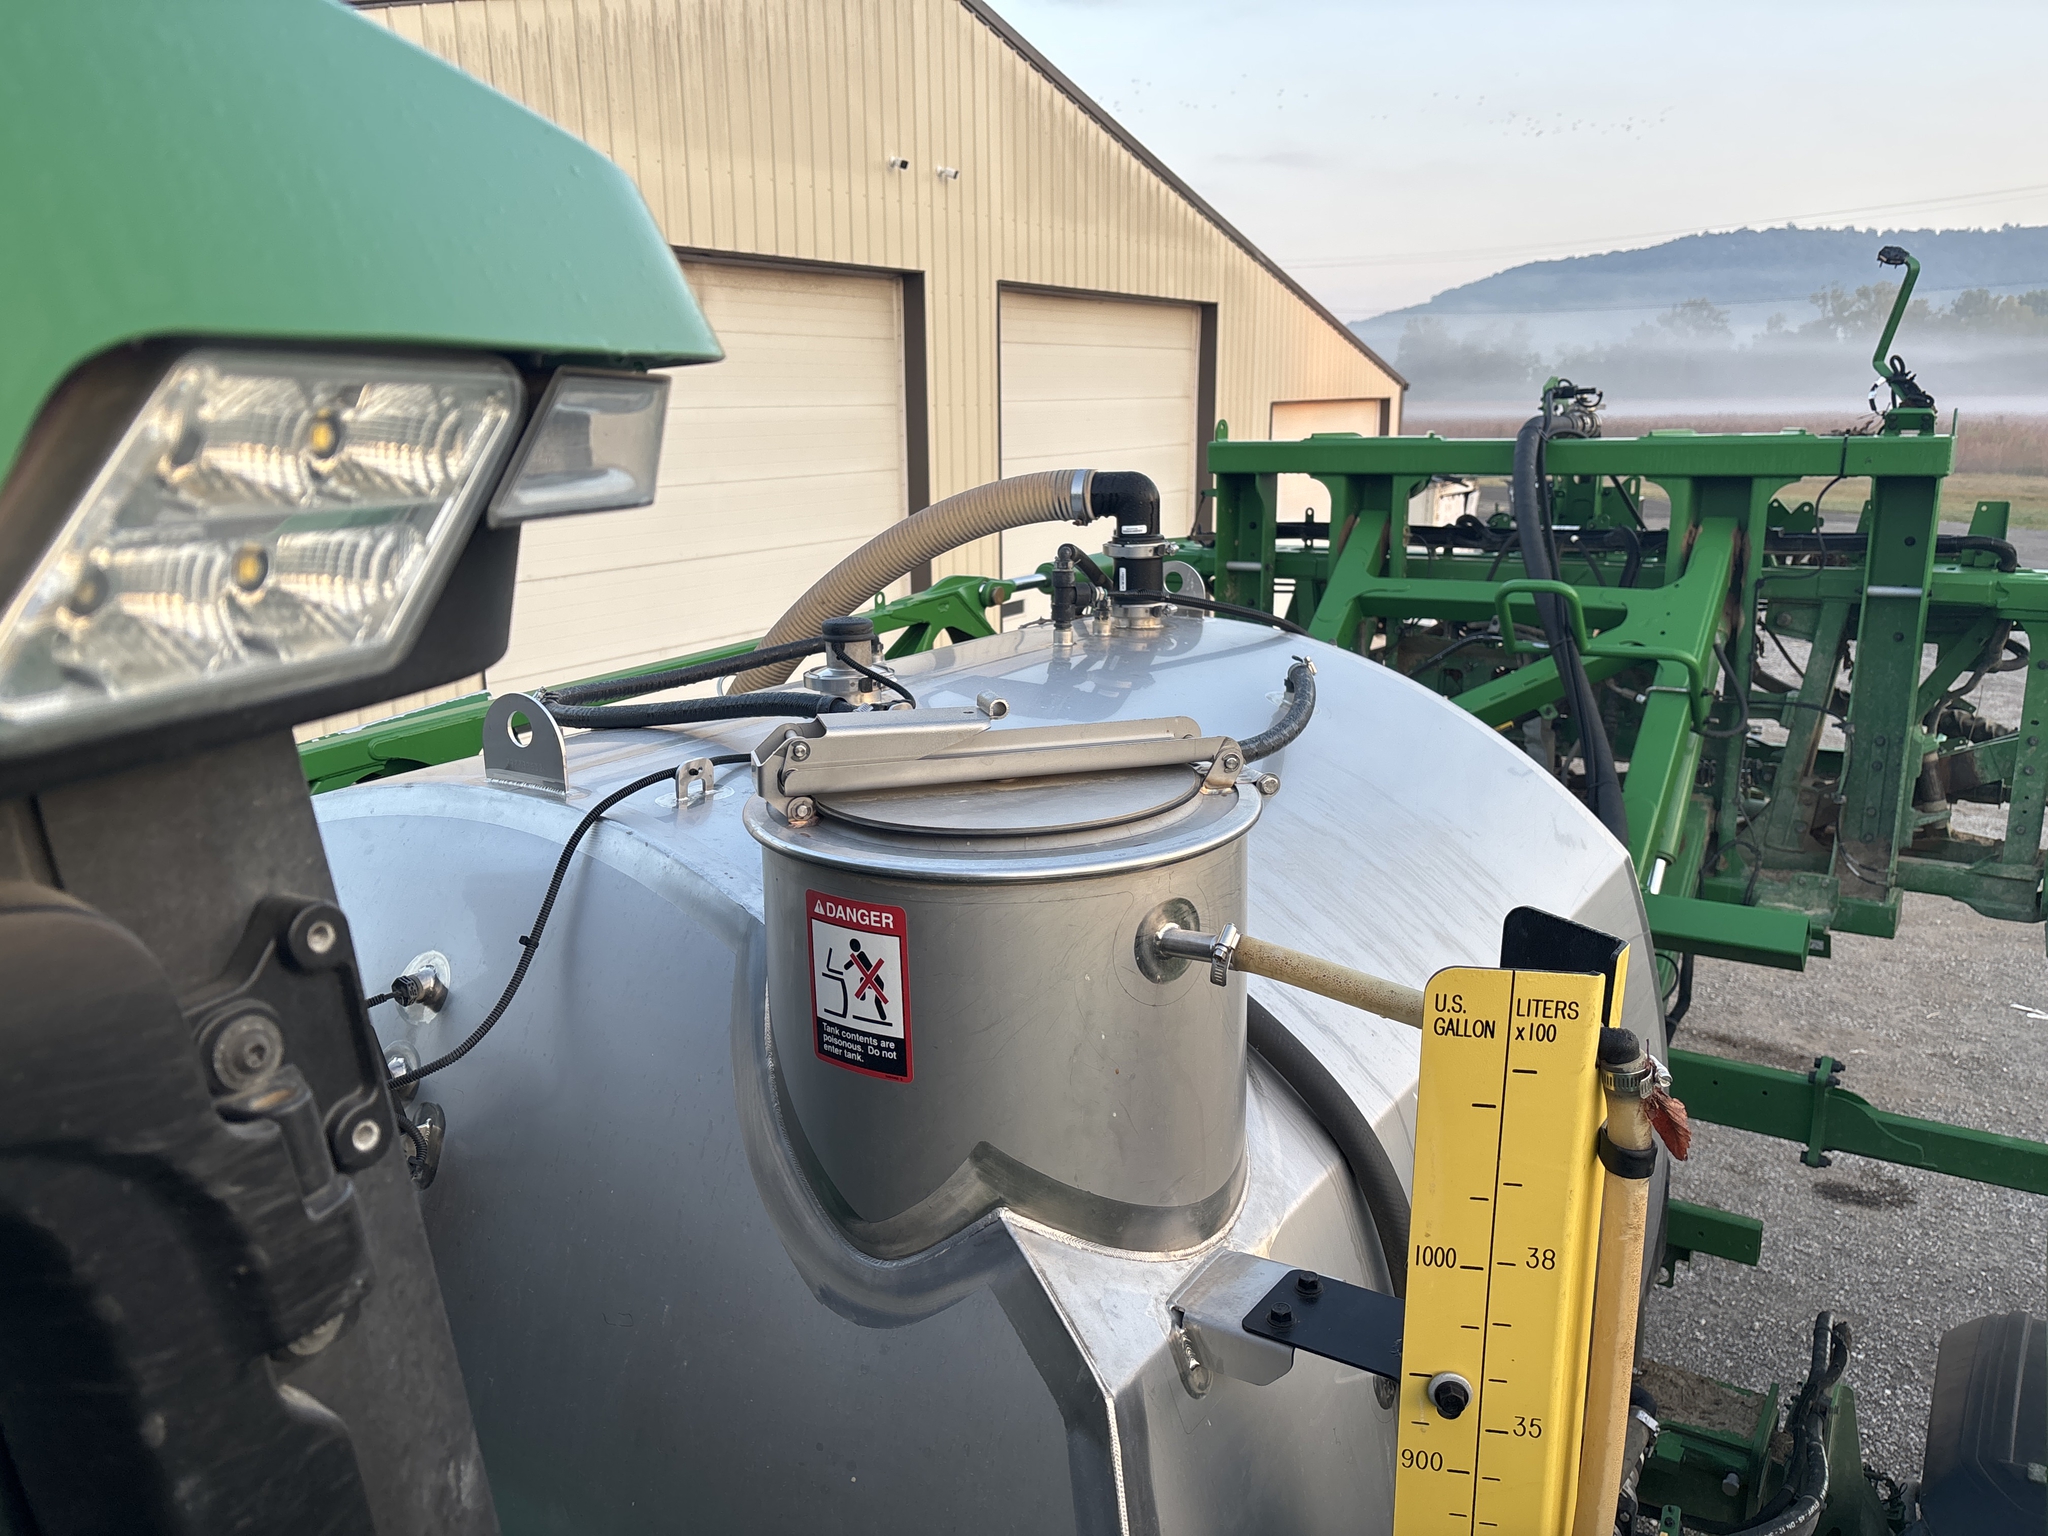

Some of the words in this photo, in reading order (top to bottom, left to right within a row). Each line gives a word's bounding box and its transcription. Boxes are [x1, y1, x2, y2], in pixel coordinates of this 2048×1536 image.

[826, 902, 894, 929] DANGER
[1434, 993, 1467, 1014] U.S.
[1516, 998, 1580, 1020] LITERS
[822, 1022, 840, 1036] Tank
[841, 1030, 878, 1046] contents
[880, 1040, 895, 1050] are
[1434, 1017, 1496, 1039] GALLON
[1515, 1023, 1557, 1043] x100
[823, 1033, 865, 1053] poisonous.
[867, 1046, 880, 1056] Do
[881, 1050, 897, 1060] not
[823, 1043, 842, 1056] enter
[844, 1049, 865, 1063] tank.
[1415, 1244, 1457, 1269] 1000
[1525, 1247, 1556, 1270] 38
[1512, 1416, 1542, 1438] 35
[1401, 1448, 1443, 1471] 900
